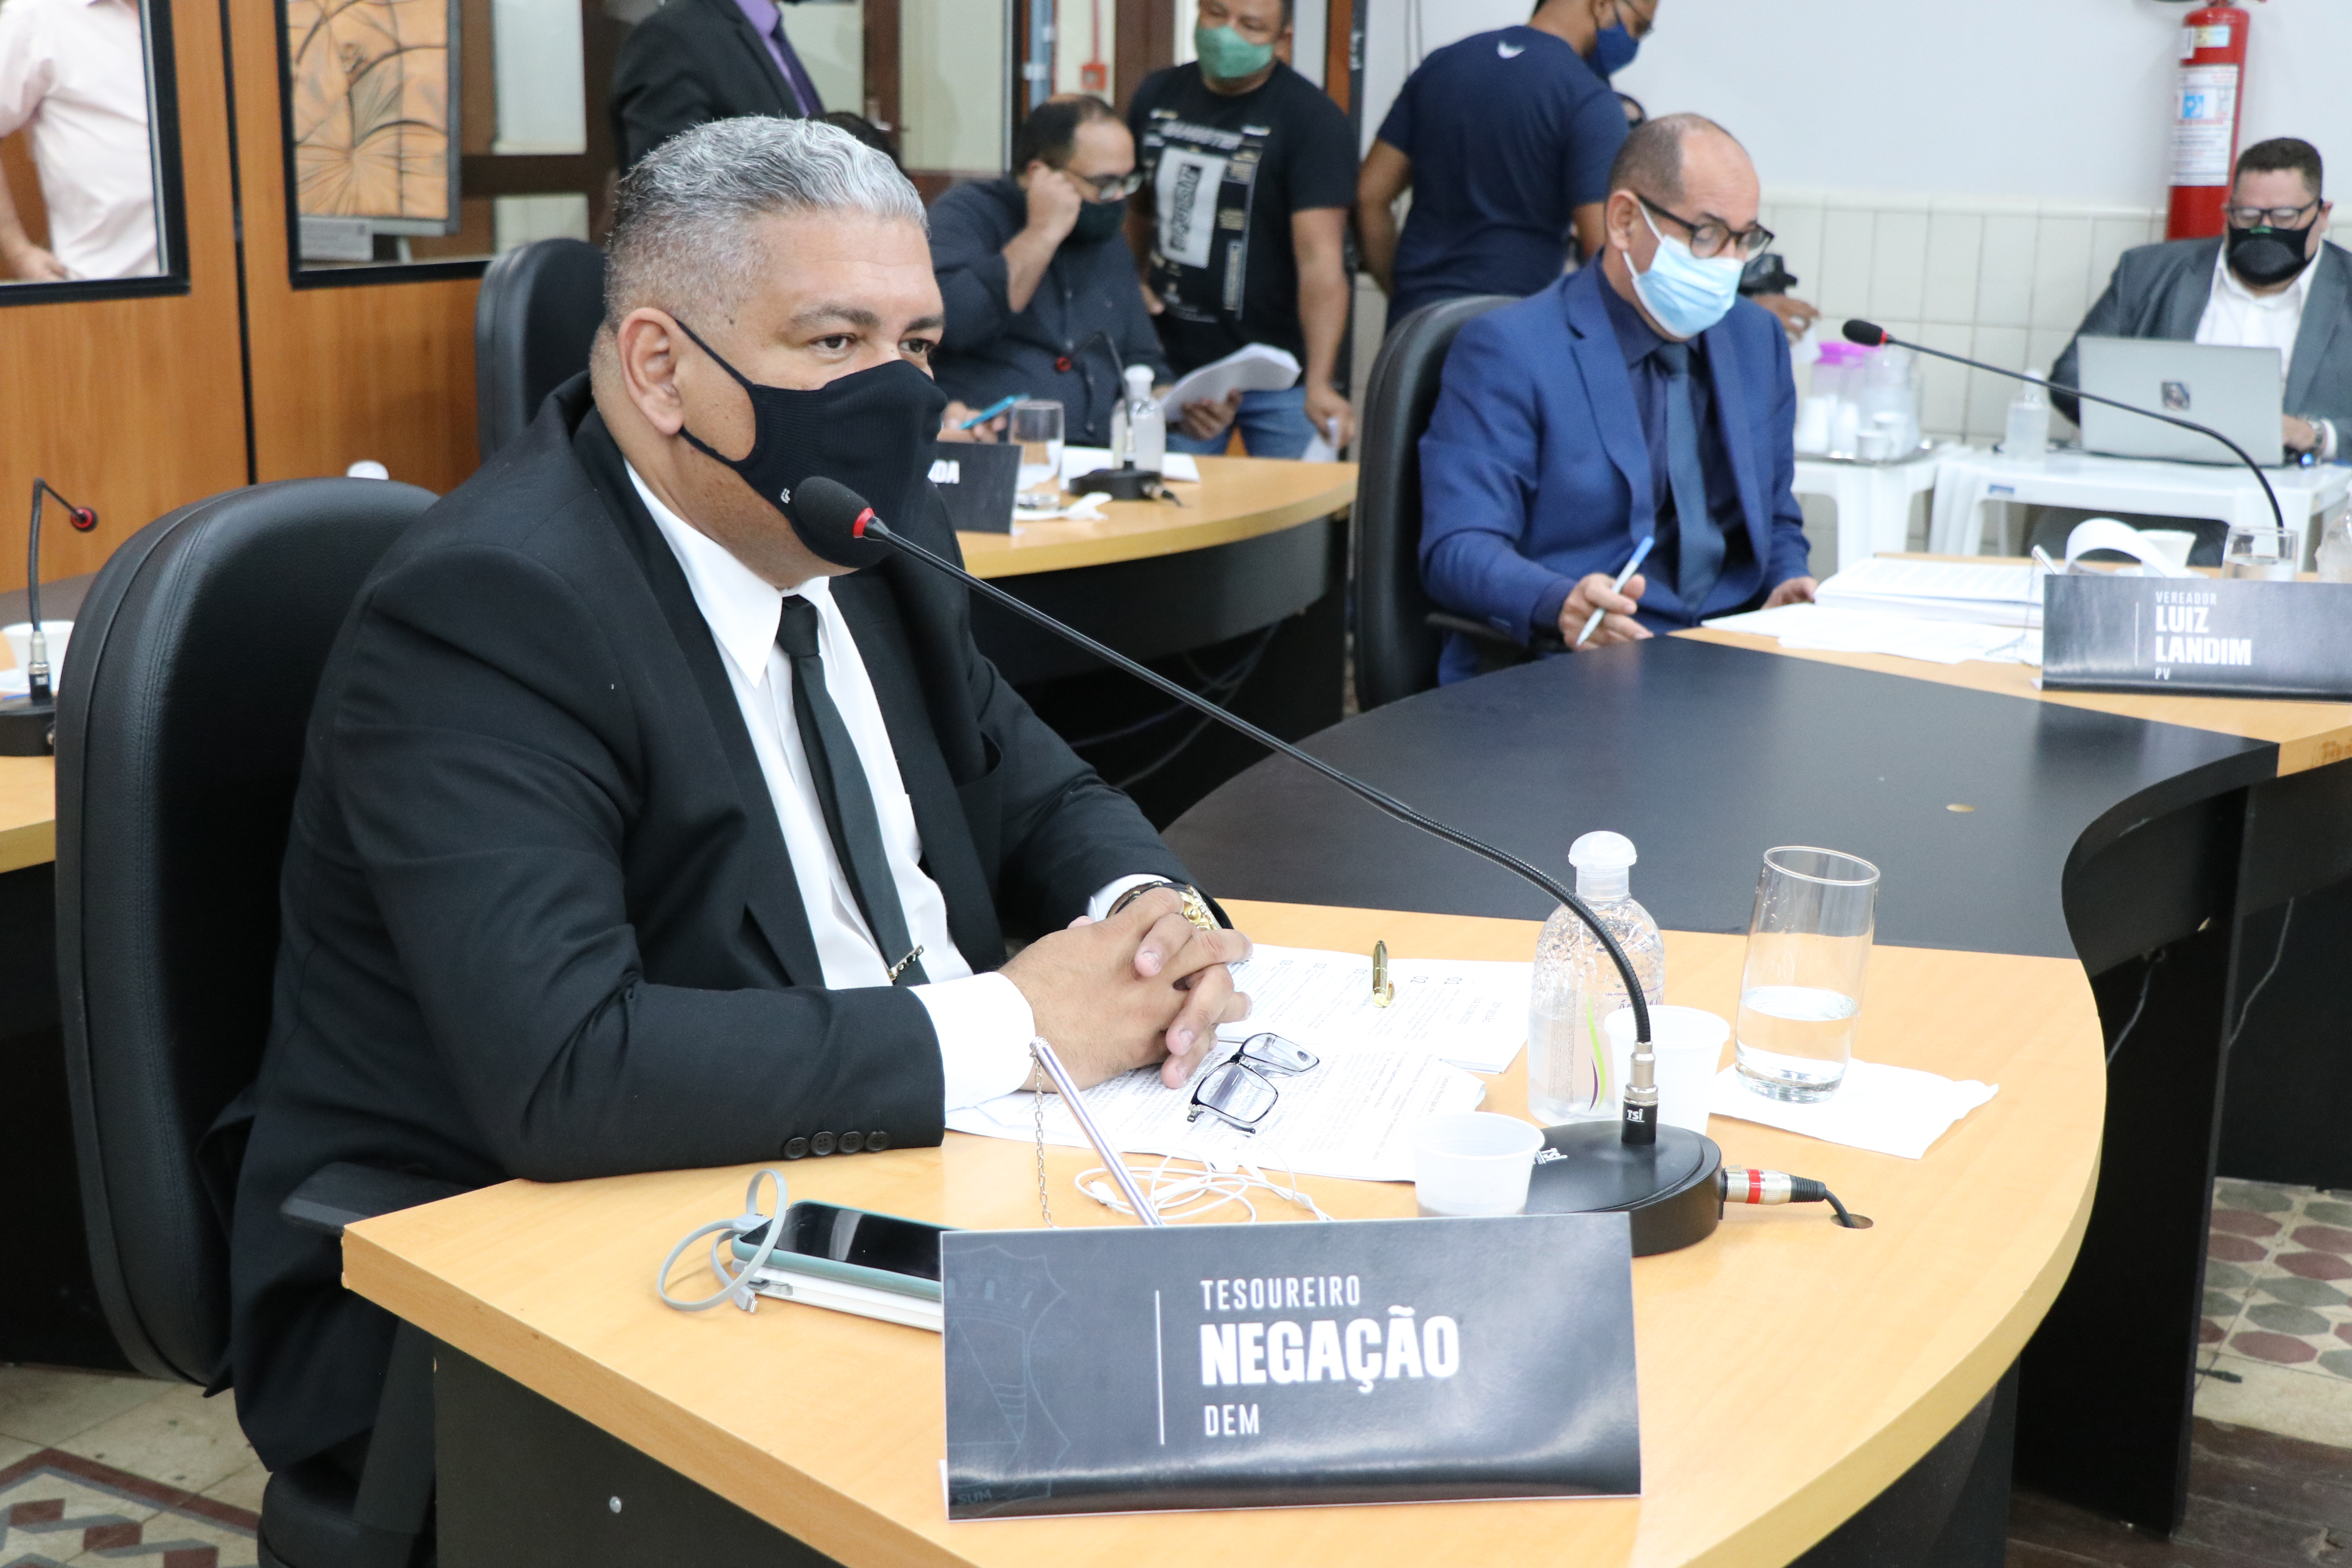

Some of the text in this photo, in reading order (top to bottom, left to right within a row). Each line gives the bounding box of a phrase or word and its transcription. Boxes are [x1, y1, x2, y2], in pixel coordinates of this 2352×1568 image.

[2156, 592, 2217, 605] VEREADOR
[2155, 605, 2209, 633] LUIZ
[2155, 636, 2252, 666] LANDIM
[2155, 668, 2170, 680] PV
[1458, 1004, 1479, 1024] 21/06/2021
[1430, 1090, 1445, 1107] Municipal
[1201, 1274, 1361, 1311] TESOUREIRO
[1201, 1305, 1459, 1393] NEGAÇÃO
[1204, 1403, 1260, 1437] DEM
